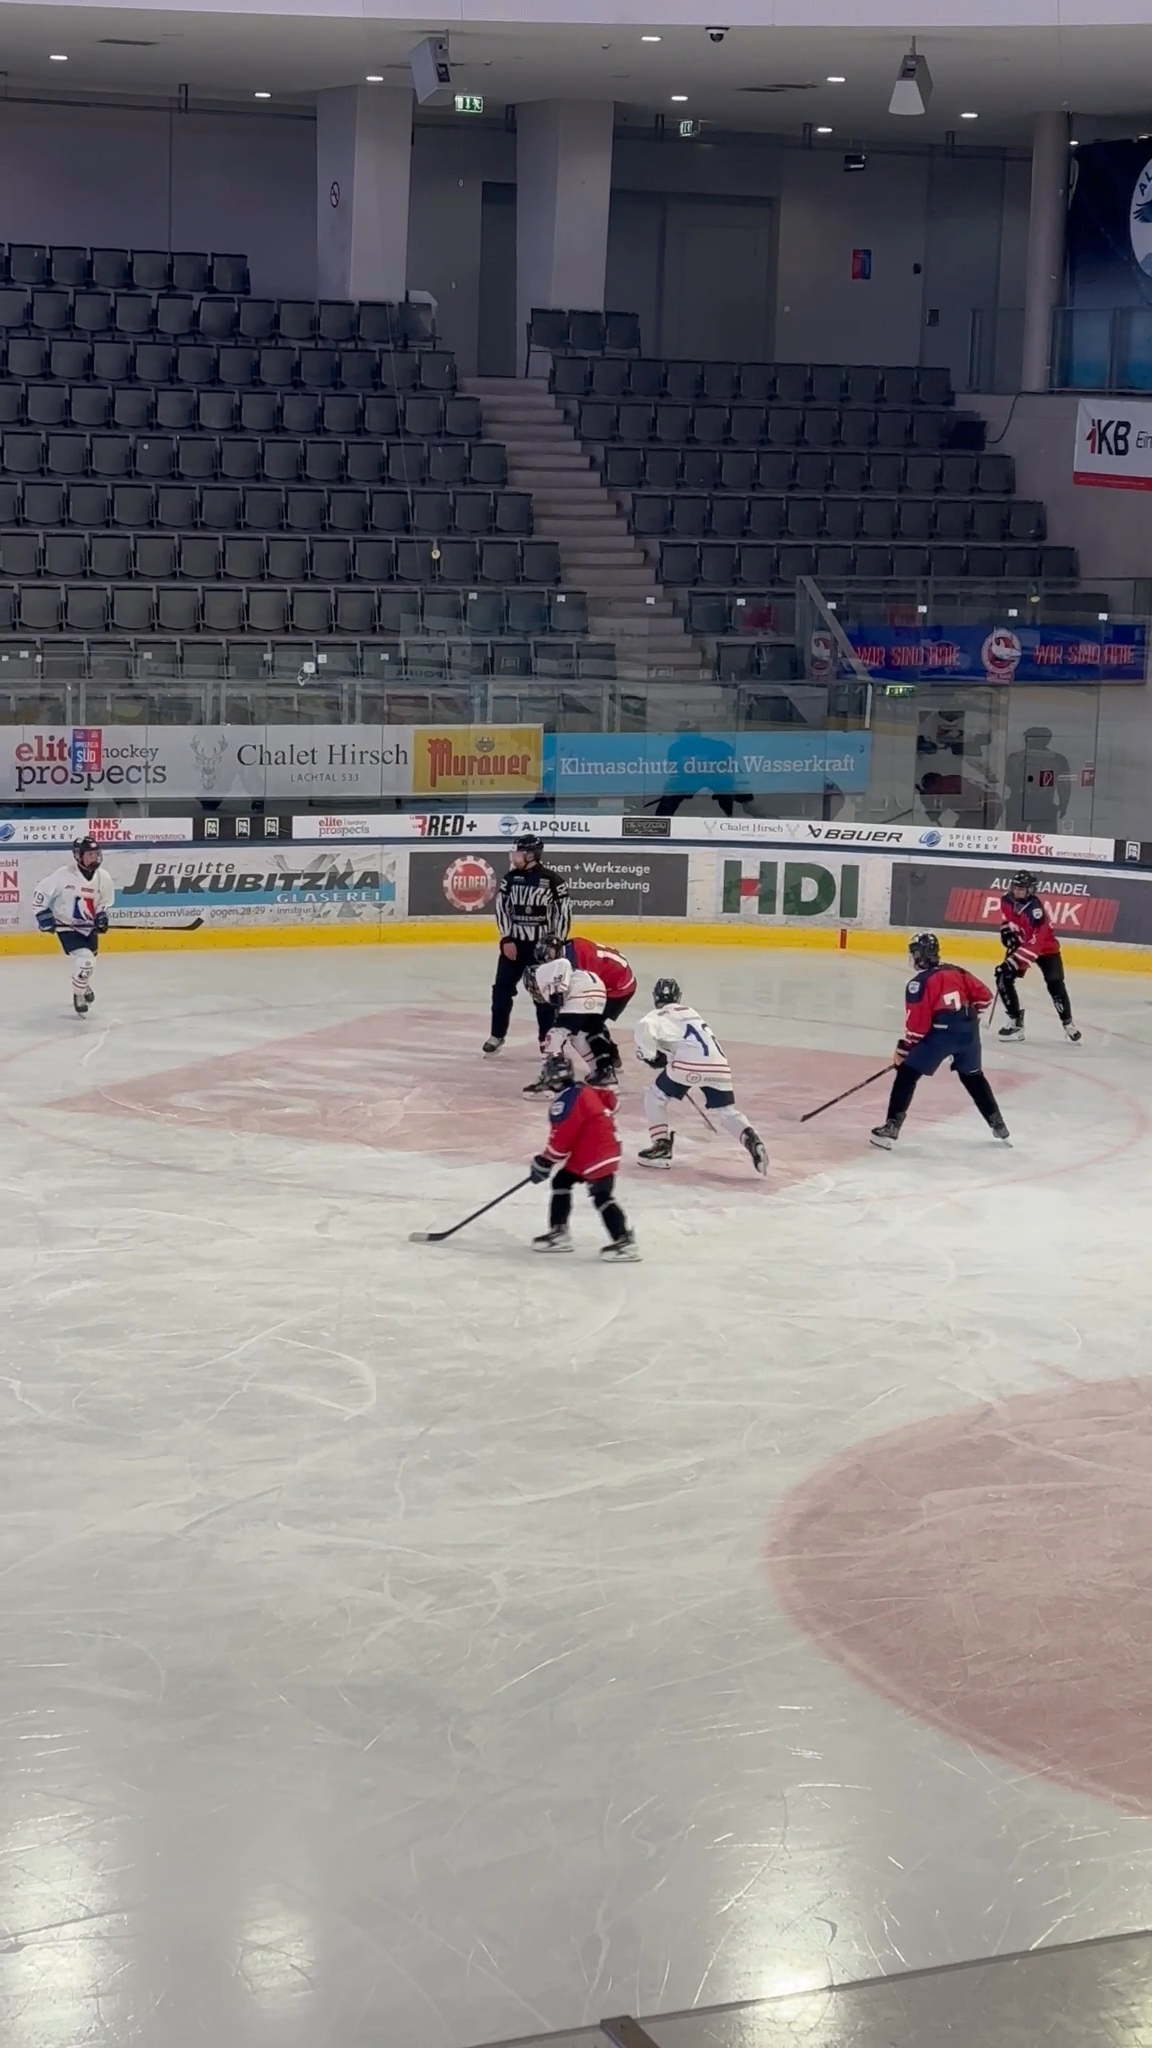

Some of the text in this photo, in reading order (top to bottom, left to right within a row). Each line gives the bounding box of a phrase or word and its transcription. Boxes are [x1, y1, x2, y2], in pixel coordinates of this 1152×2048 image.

[15, 735, 73, 762] elit
[76, 748, 96, 763] SÜD
[237, 743, 408, 766] Chalet Hirsch
[427, 738, 531, 787] Murauer
[560, 754, 855, 776] Klimaschutz durch Wasserkraft
[290, 773, 359, 782] LACHTAL 533
[462, 778, 495, 786] BIER
[318, 817, 342, 827] elite
[521, 820, 590, 833] ALPQUELL
[23, 833, 74, 841] HOCKEY
[89, 830, 131, 841] BRUCK
[318, 825, 370, 837] prospects
[824, 828, 904, 843] BAUER
[949, 833, 984, 841] SPIRIT
[949, 842, 998, 850] HOCKEY
[1011, 844, 1054, 856] BRUCK
[155, 861, 235, 877] Brigitte
[544, 861, 571, 873] inen
[583, 861, 651, 876] Werkzeuge
[122, 863, 380, 895] JAKUBITZKA
[452, 875, 489, 890] FELDER
[990, 876, 1091, 897] AUHANDEL
[276, 890, 380, 903] GLASEREI
[722, 860, 859, 918] HDI
[982, 896, 1083, 926] PNK
